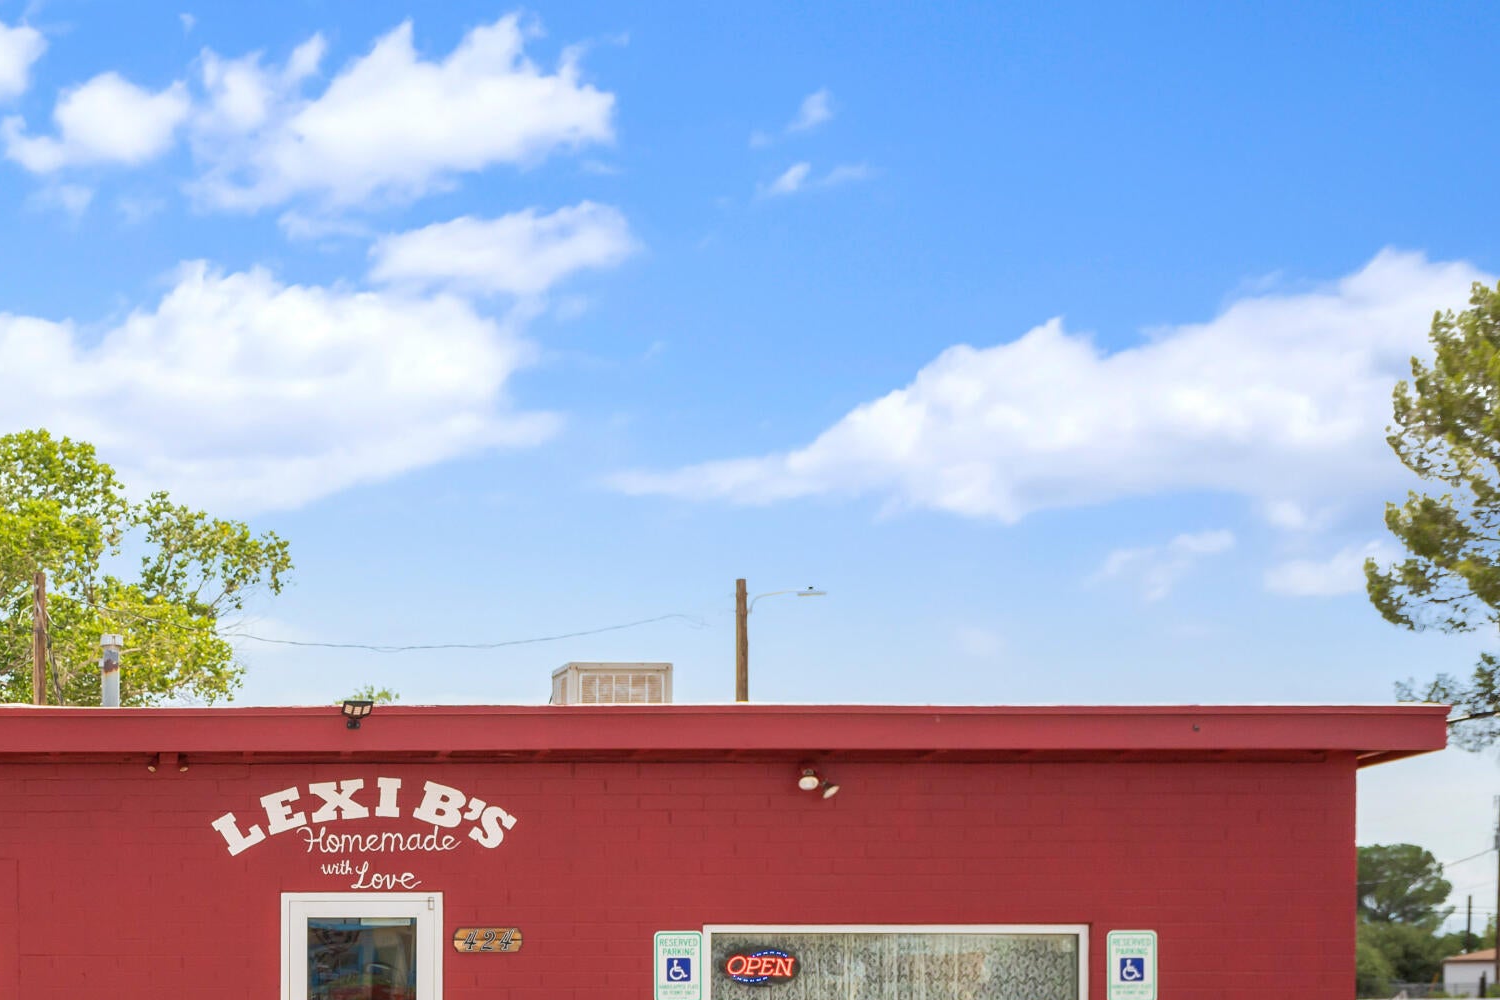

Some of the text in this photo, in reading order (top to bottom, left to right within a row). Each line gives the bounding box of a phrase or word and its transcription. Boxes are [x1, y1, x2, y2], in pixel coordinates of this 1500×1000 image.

[211, 777, 517, 856] LEXI B'S
[297, 825, 461, 853] Homemade
[321, 860, 421, 889] with Love
[463, 928, 515, 951] 424
[659, 938, 698, 947] RESERVED
[662, 947, 695, 956] PARKING
[727, 954, 795, 977] OPEN
